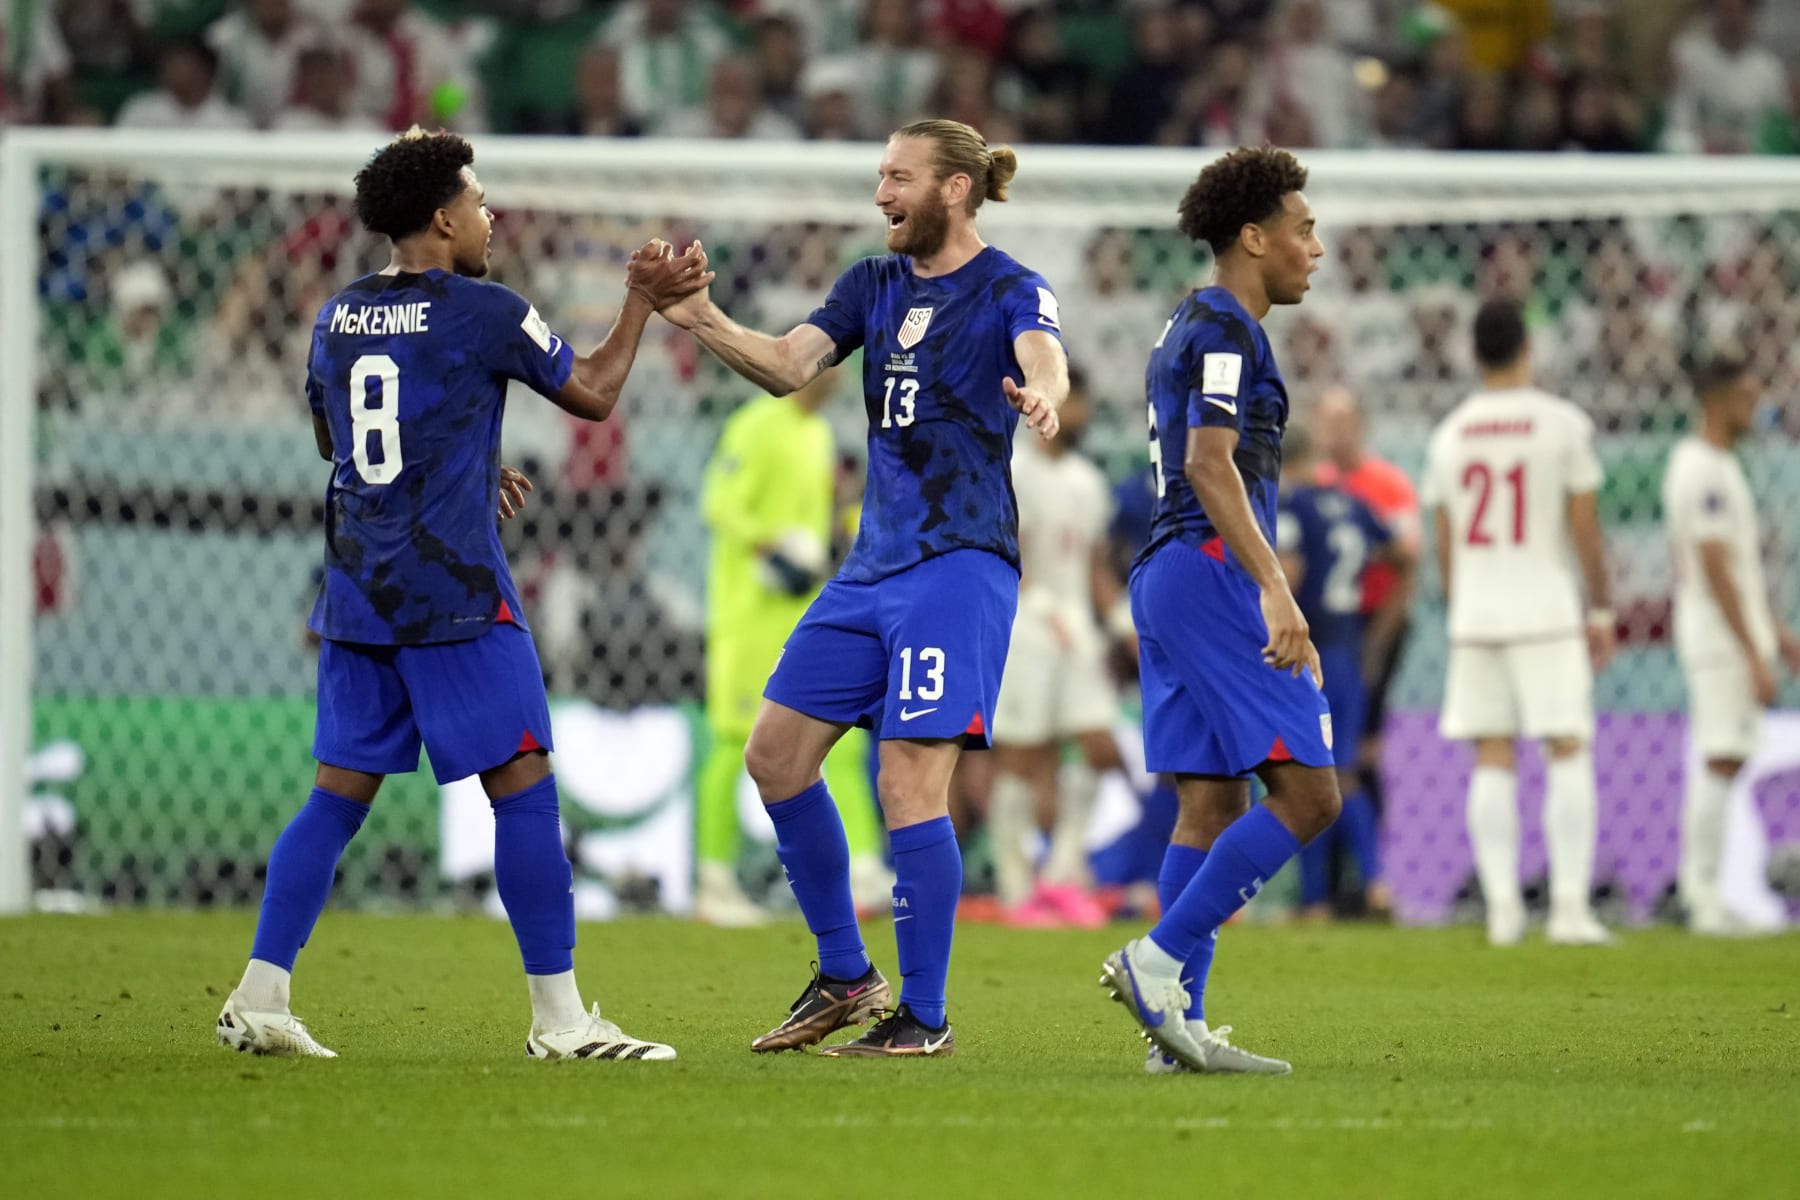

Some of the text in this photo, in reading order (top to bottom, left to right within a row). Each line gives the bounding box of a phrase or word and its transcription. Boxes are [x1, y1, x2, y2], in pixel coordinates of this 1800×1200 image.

[330, 302, 431, 334] McKENNIE
[350, 355, 403, 484] 8
[881, 376, 920, 428] 13
[1462, 462, 1526, 545] 21
[1323, 521, 1366, 612] 2
[899, 647, 945, 700] 13
[891, 896, 909, 908] SA
